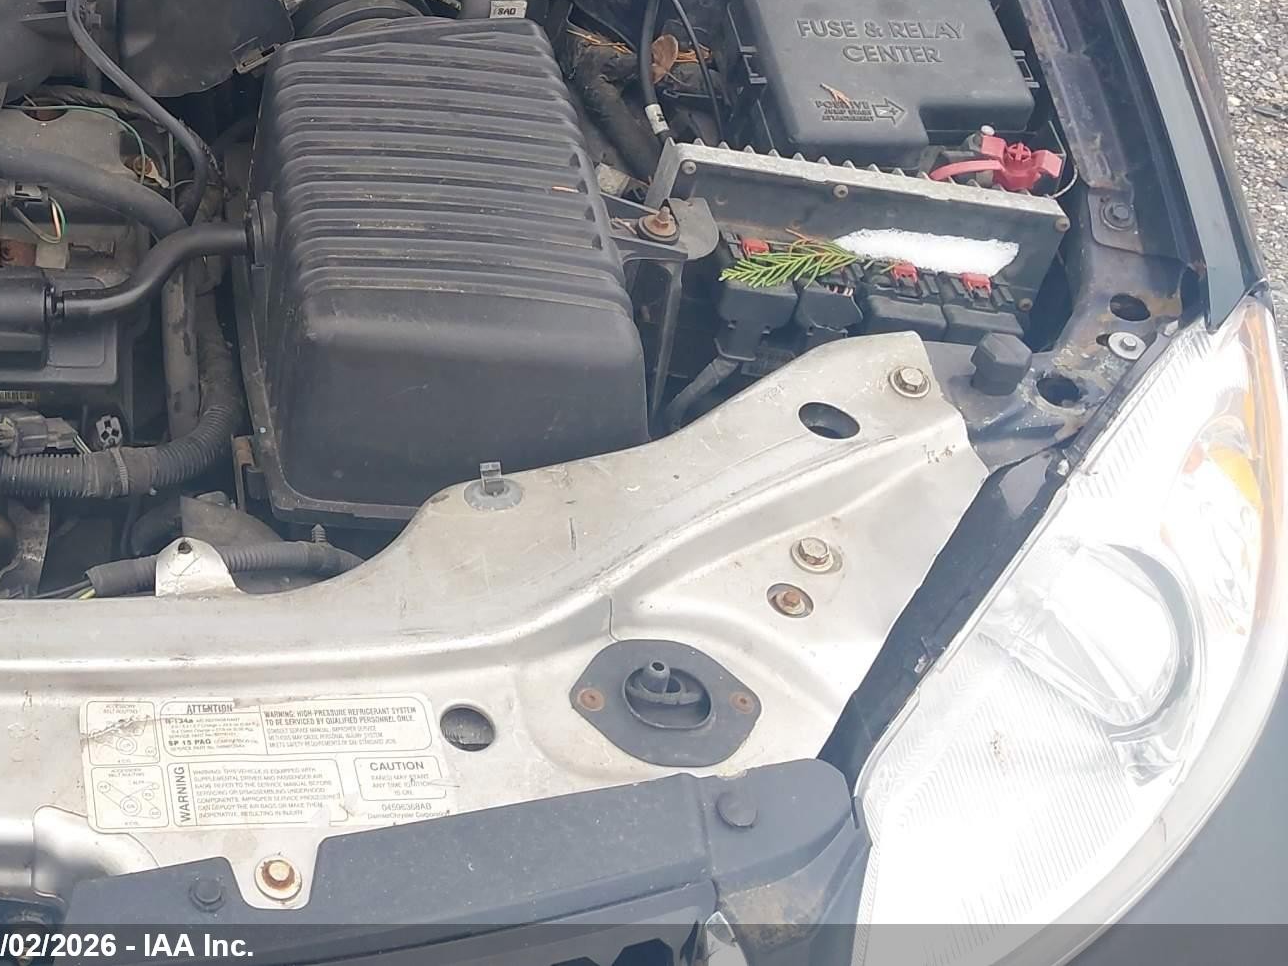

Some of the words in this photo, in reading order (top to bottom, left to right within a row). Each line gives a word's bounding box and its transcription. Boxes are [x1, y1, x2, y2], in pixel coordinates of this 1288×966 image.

[796, 19, 858, 38] FUSE
[864, 20, 883, 38] &
[887, 19, 964, 39] RELAY
[842, 44, 944, 63] CENTER
[815, 100, 871, 110] POIVE
[187, 704, 233, 714] ATTENTION
[348, 707, 390, 716] REFRIGERANT
[392, 706, 417, 714] SYSTEM
[316, 717, 324, 725] BY
[325, 716, 358, 725] QUALIFIED
[359, 715, 397, 724] PERSONNEL
[369, 761, 425, 771] CAUTION
[173, 766, 192, 823] WARNING
